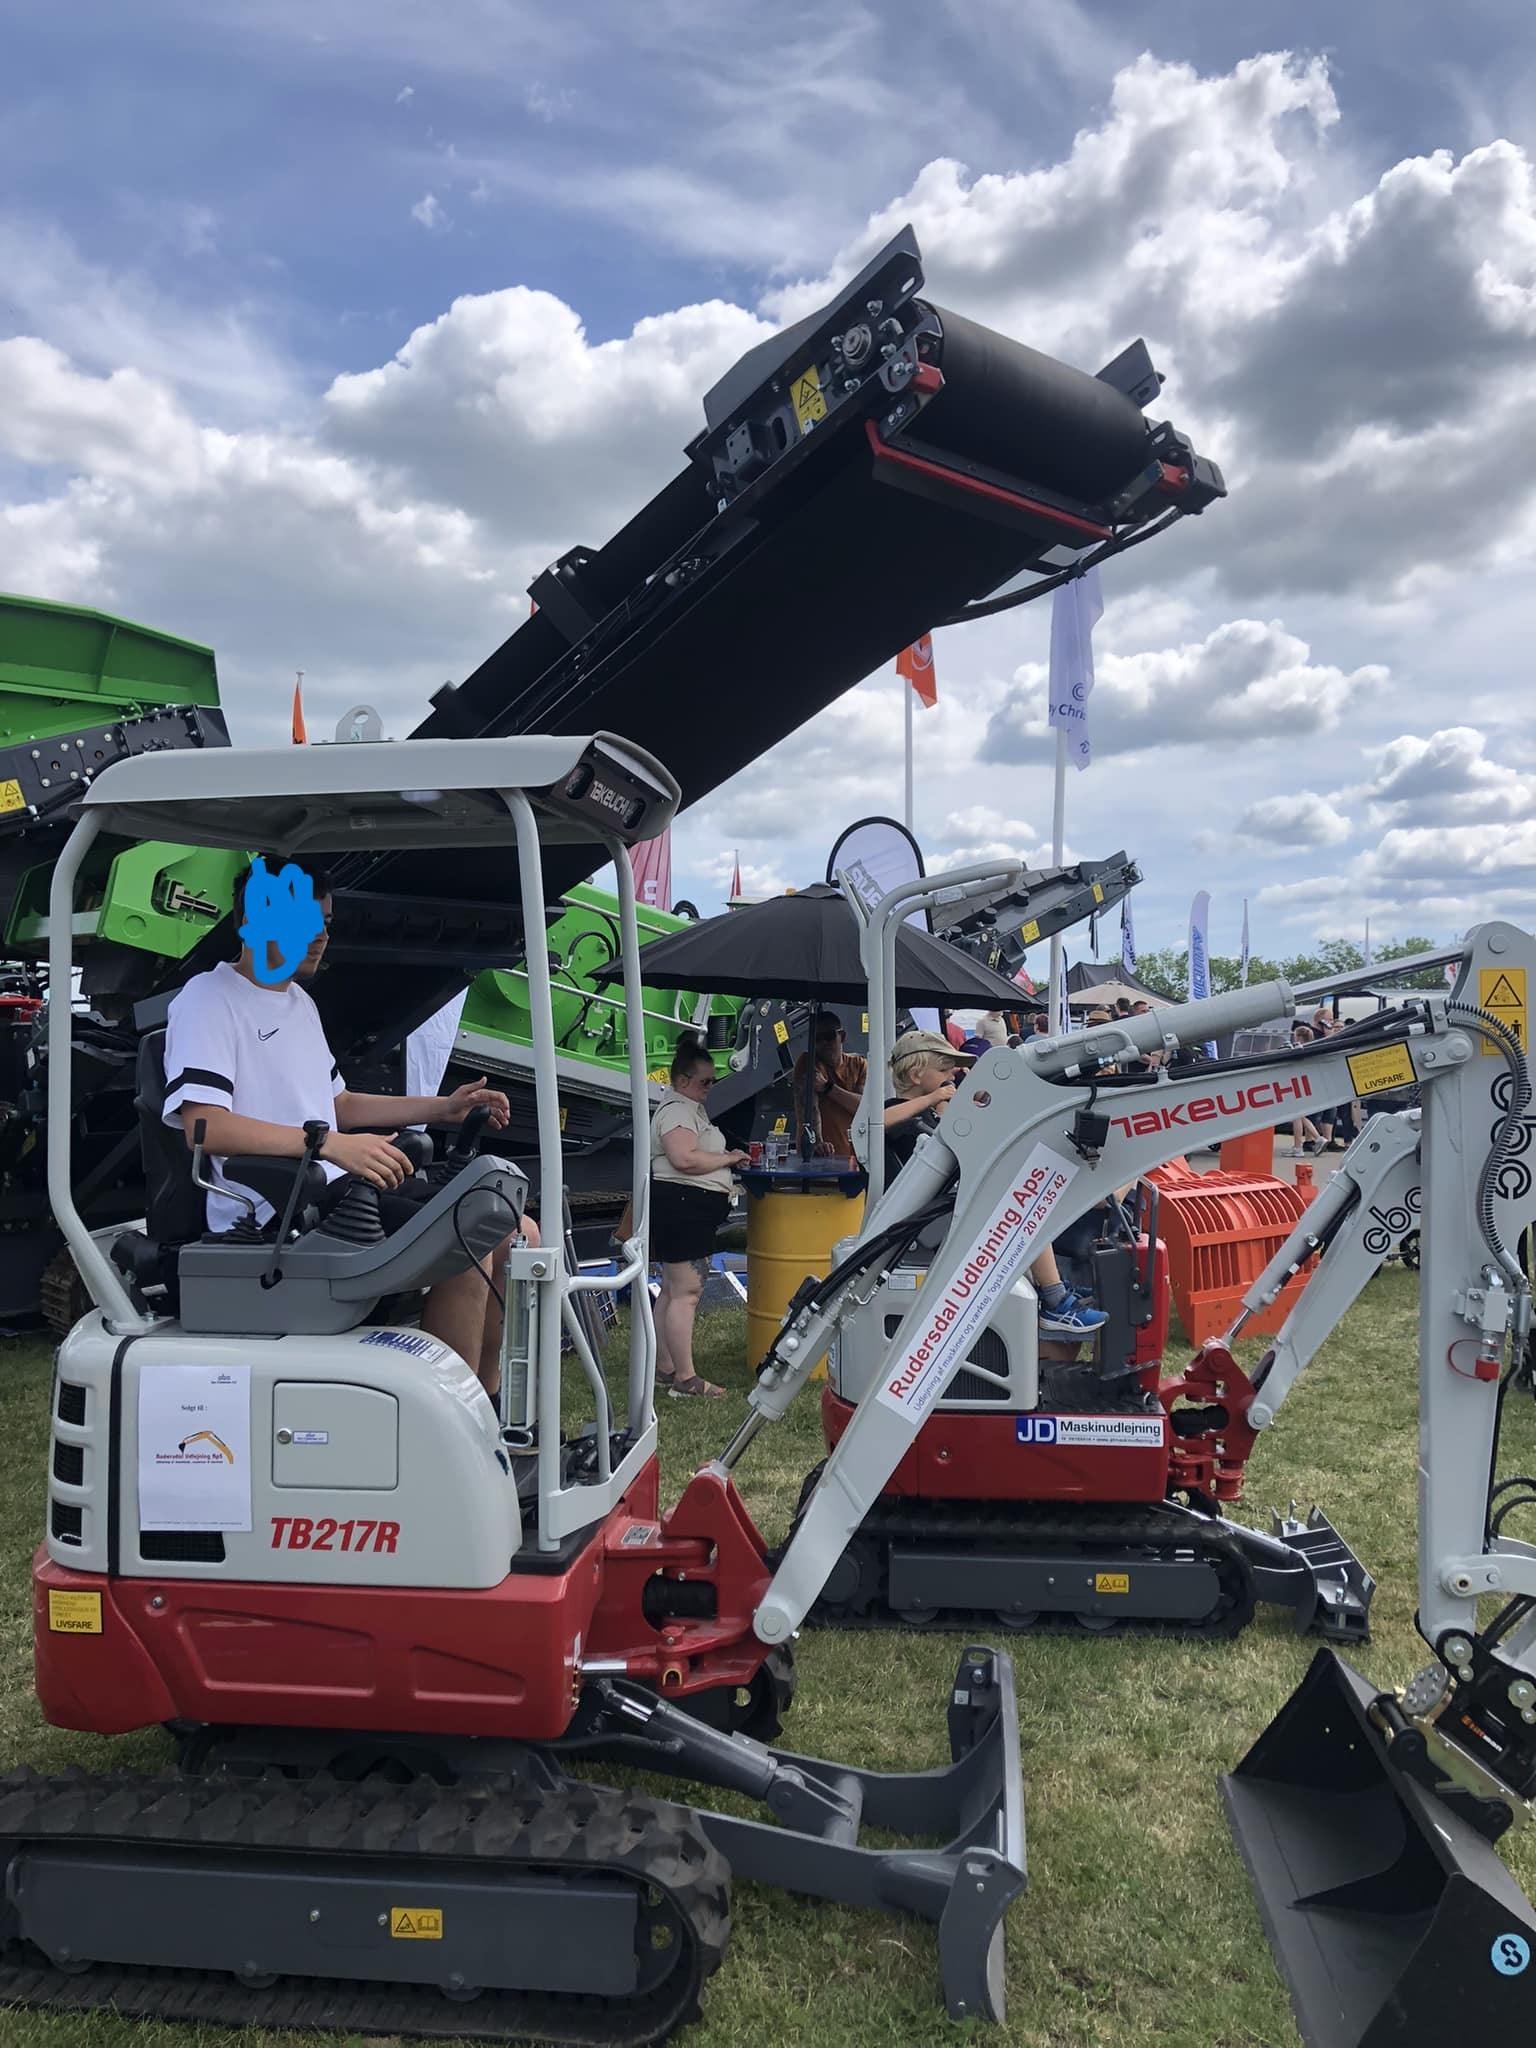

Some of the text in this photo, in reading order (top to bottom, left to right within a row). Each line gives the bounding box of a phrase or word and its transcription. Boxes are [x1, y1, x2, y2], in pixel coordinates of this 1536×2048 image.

[1364, 1072, 1406, 1090] LIVSFARE
[1110, 1075, 1312, 1139] TAKEUCHI
[1023, 1173, 1068, 1237] 20 25 35 42
[888, 1165, 1050, 1400] Rudersdal Udlejning Aps.
[913, 1374, 942, 1412] Udlejning
[942, 1333, 966, 1370] maskiner
[962, 1323, 974, 1338] og
[969, 1295, 993, 1330] værktøj
[1001, 1263, 1011, 1278] til
[1017, 1419, 1055, 1442] JD
[1060, 1420, 1161, 1437] Maskinudlejning
[270, 1517, 401, 1554] TB217R
[56, 1620, 94, 1630] LIVSFARE
